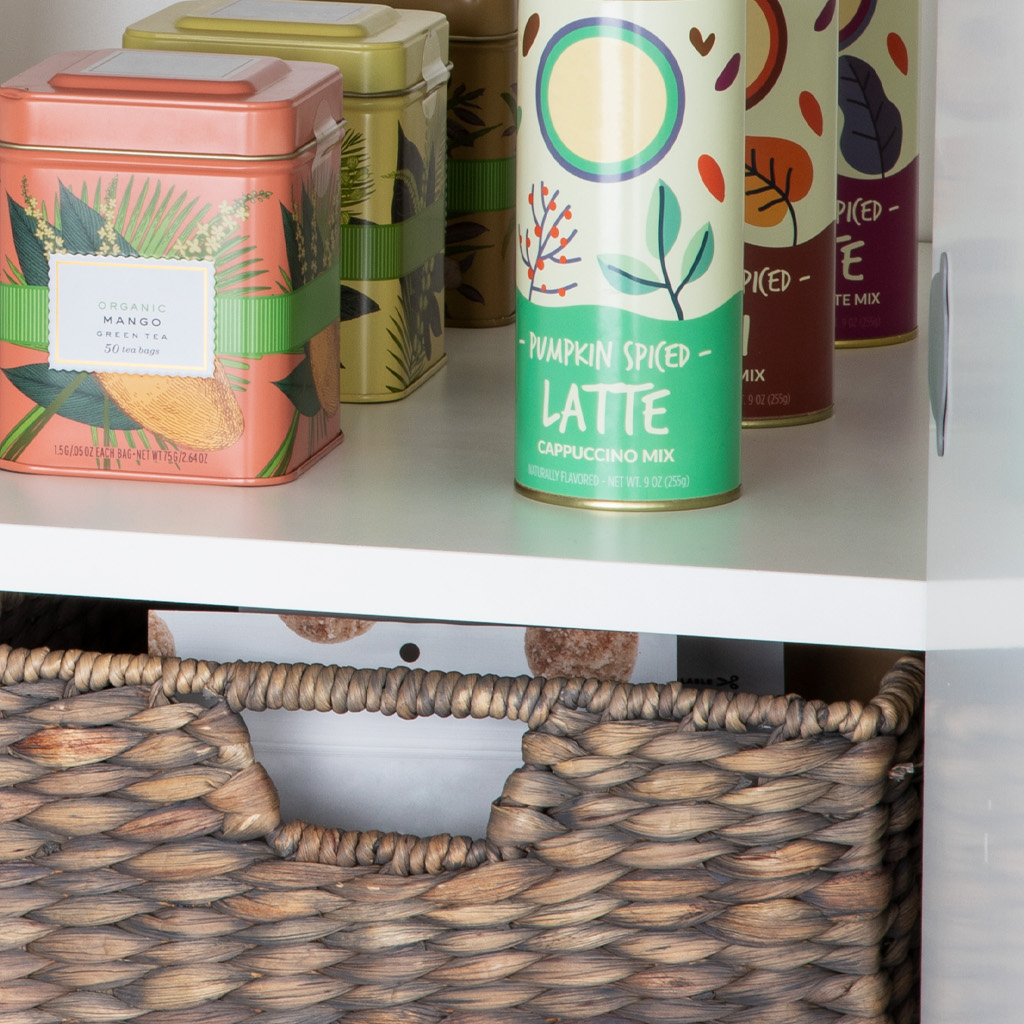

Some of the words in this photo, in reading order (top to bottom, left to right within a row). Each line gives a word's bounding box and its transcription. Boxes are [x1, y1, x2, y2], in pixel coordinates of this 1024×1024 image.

[836, 197, 882, 226] PICED
[743, 266, 791, 297] PICED
[854, 292, 881, 306] MIX
[98, 301, 167, 313] ORGANIC
[103, 316, 162, 327] MANGO
[96, 330, 139, 339] GREEN
[104, 343, 120, 354] 50
[122, 346, 136, 354] tea
[138, 346, 160, 356] bags
[529, 331, 613, 370] PUMPKIN
[623, 340, 690, 373] SPICED
[542, 378, 671, 436] LATTE
[748, 394, 754, 405] 9
[96, 447, 115, 458] EACH
[152, 450, 162, 462] WT
[537, 439, 638, 464] CAPPUCCINO
[642, 448, 676, 463] MIX
[528, 464, 560, 481] NATURALLY
[561, 471, 600, 487] FLAVORED
[608, 476, 624, 488] NET
[626, 476, 641, 488] WT.
[644, 477, 649, 488] 9
[652, 476, 662, 488] OZ
[665, 474, 690, 489] (255g)
